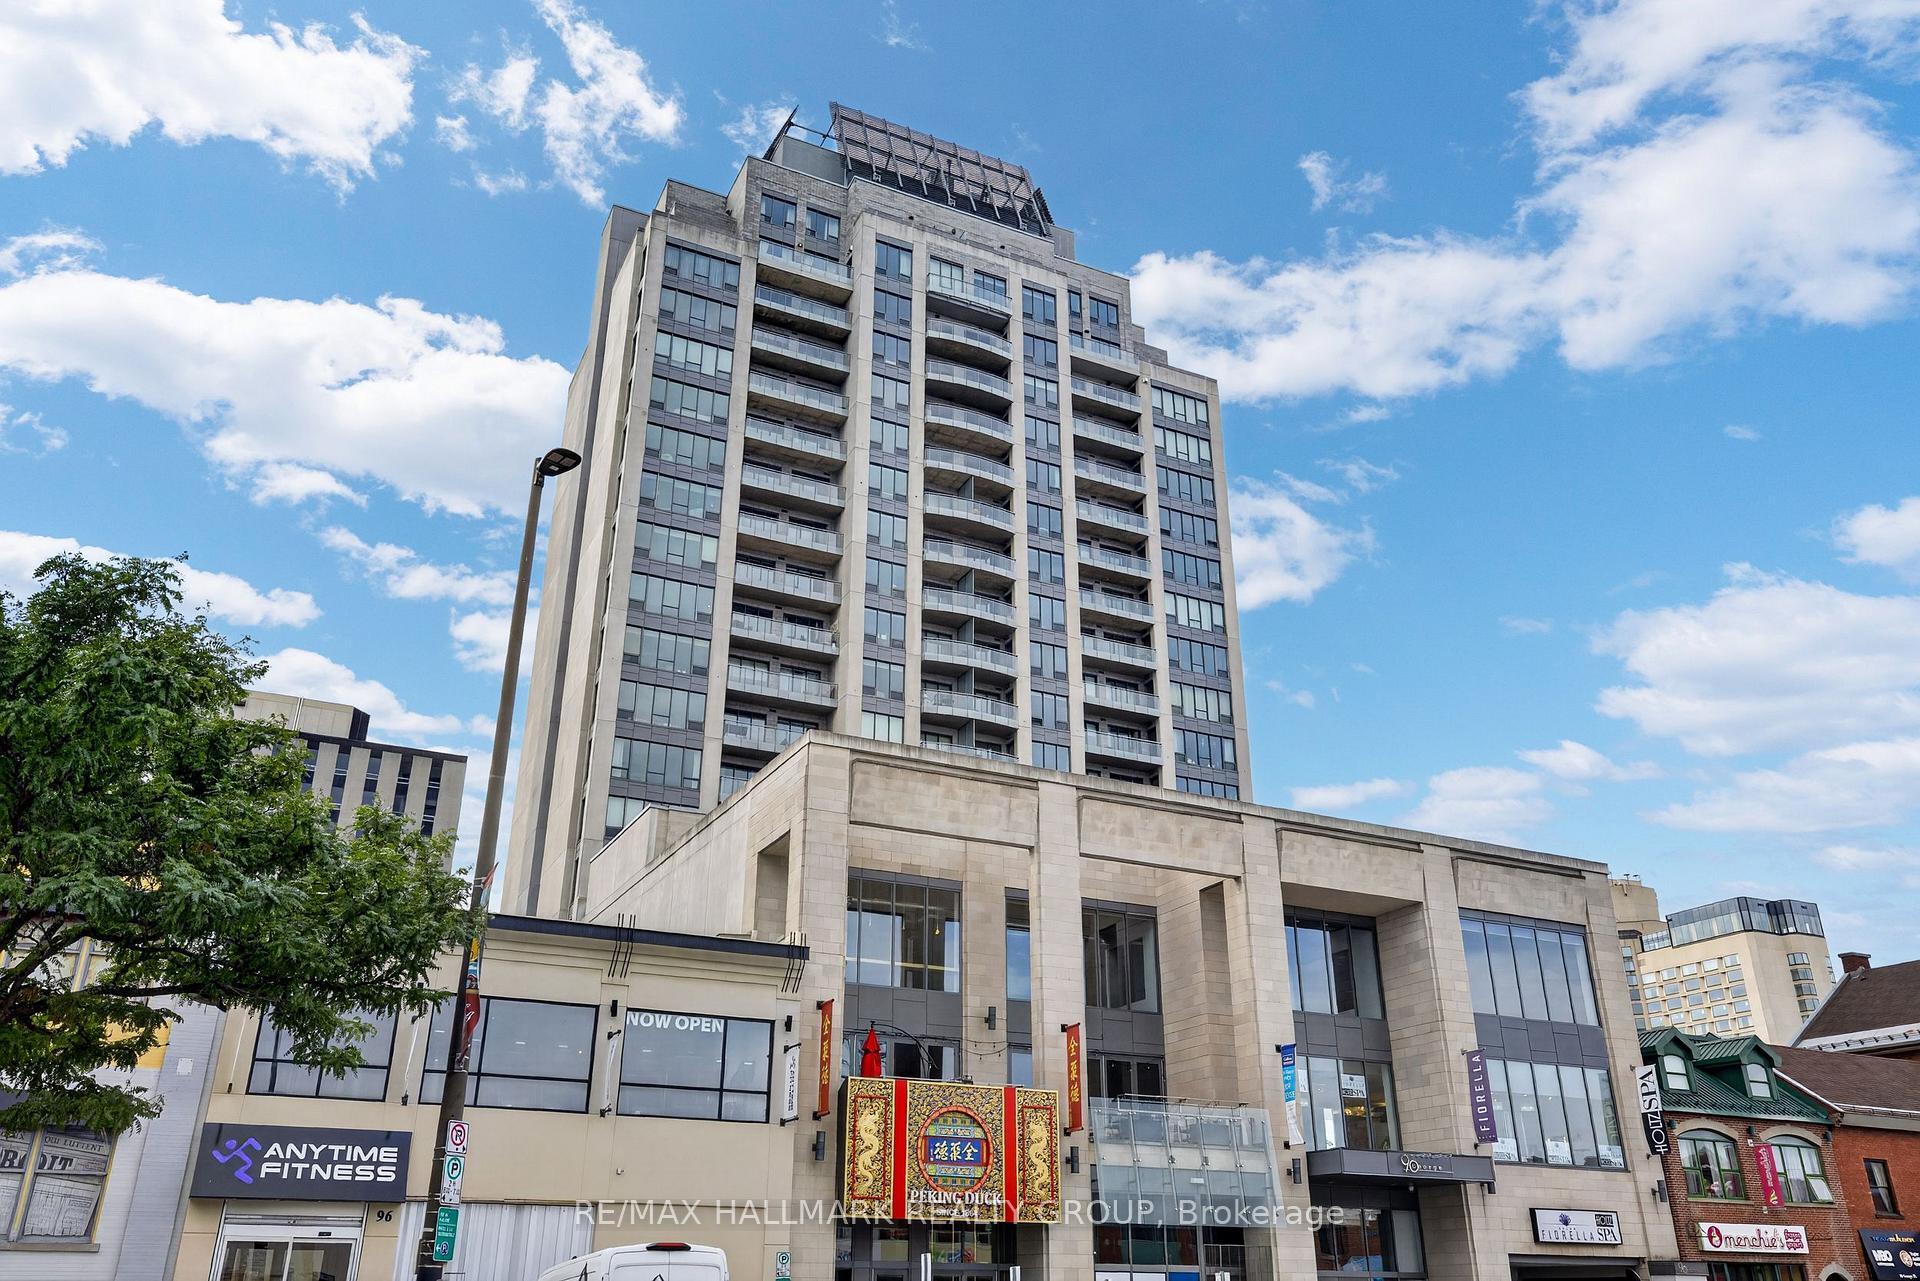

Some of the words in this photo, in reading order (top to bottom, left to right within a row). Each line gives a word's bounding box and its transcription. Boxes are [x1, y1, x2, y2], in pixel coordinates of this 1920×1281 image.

[626, 1011, 672, 1029] NOW
[675, 1015, 724, 1033] OPEN
[1472, 1055, 1490, 1132] FIORELLA
[1639, 1069, 1659, 1110] SPA
[263, 1142, 399, 1163] ANYTIME
[259, 1162, 397, 1182] FITNESS
[910, 1190, 962, 1204] PEKING
[965, 1191, 1004, 1206] DUCK
[377, 1210, 393, 1223] 96
[1541, 1229, 1595, 1241] FIORELLA
[1597, 1228, 1618, 1242] SPA
